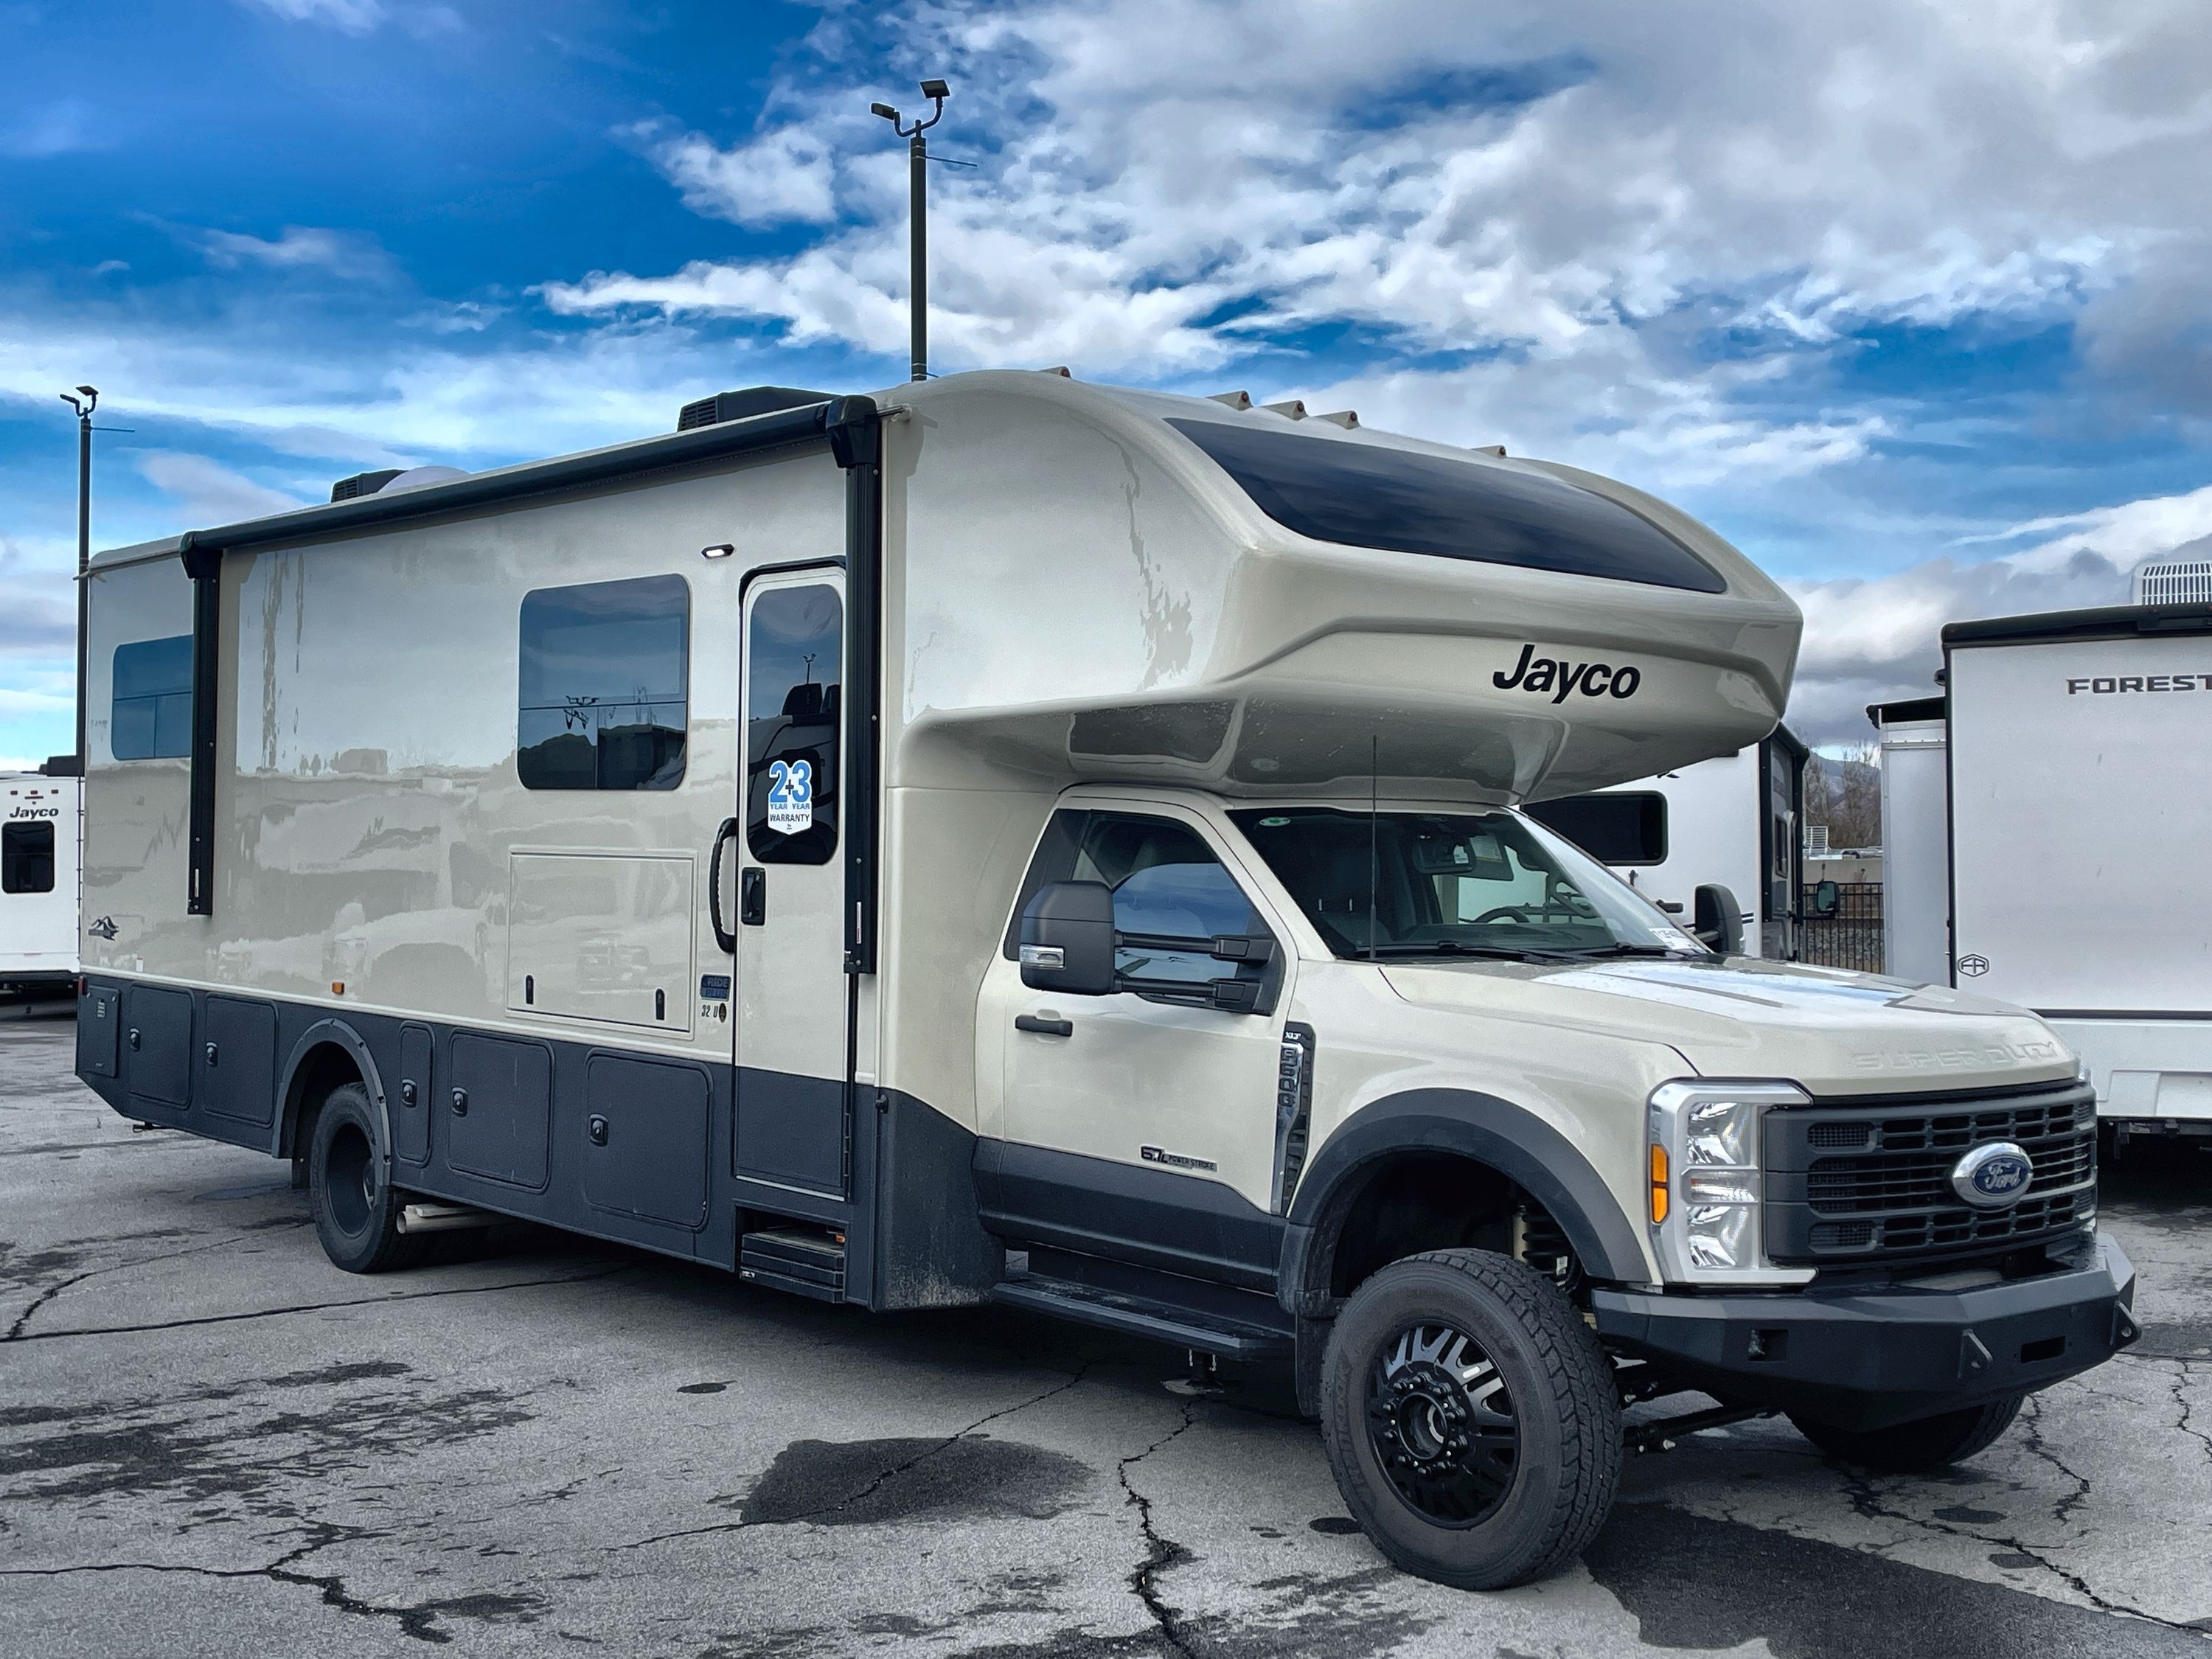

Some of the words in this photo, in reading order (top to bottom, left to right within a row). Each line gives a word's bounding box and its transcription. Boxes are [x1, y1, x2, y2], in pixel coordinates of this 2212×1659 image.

[1493, 644, 1641, 704] Jayco
[10, 807, 59, 820] Jayco
[770, 813, 810, 822] WARRANTY
[701, 1004, 711, 1018] 32
[1853, 1050, 1986, 1068] SUPER
[1984, 1041, 2058, 1065] DUTY
[1984, 1162, 2020, 1190] Ford
